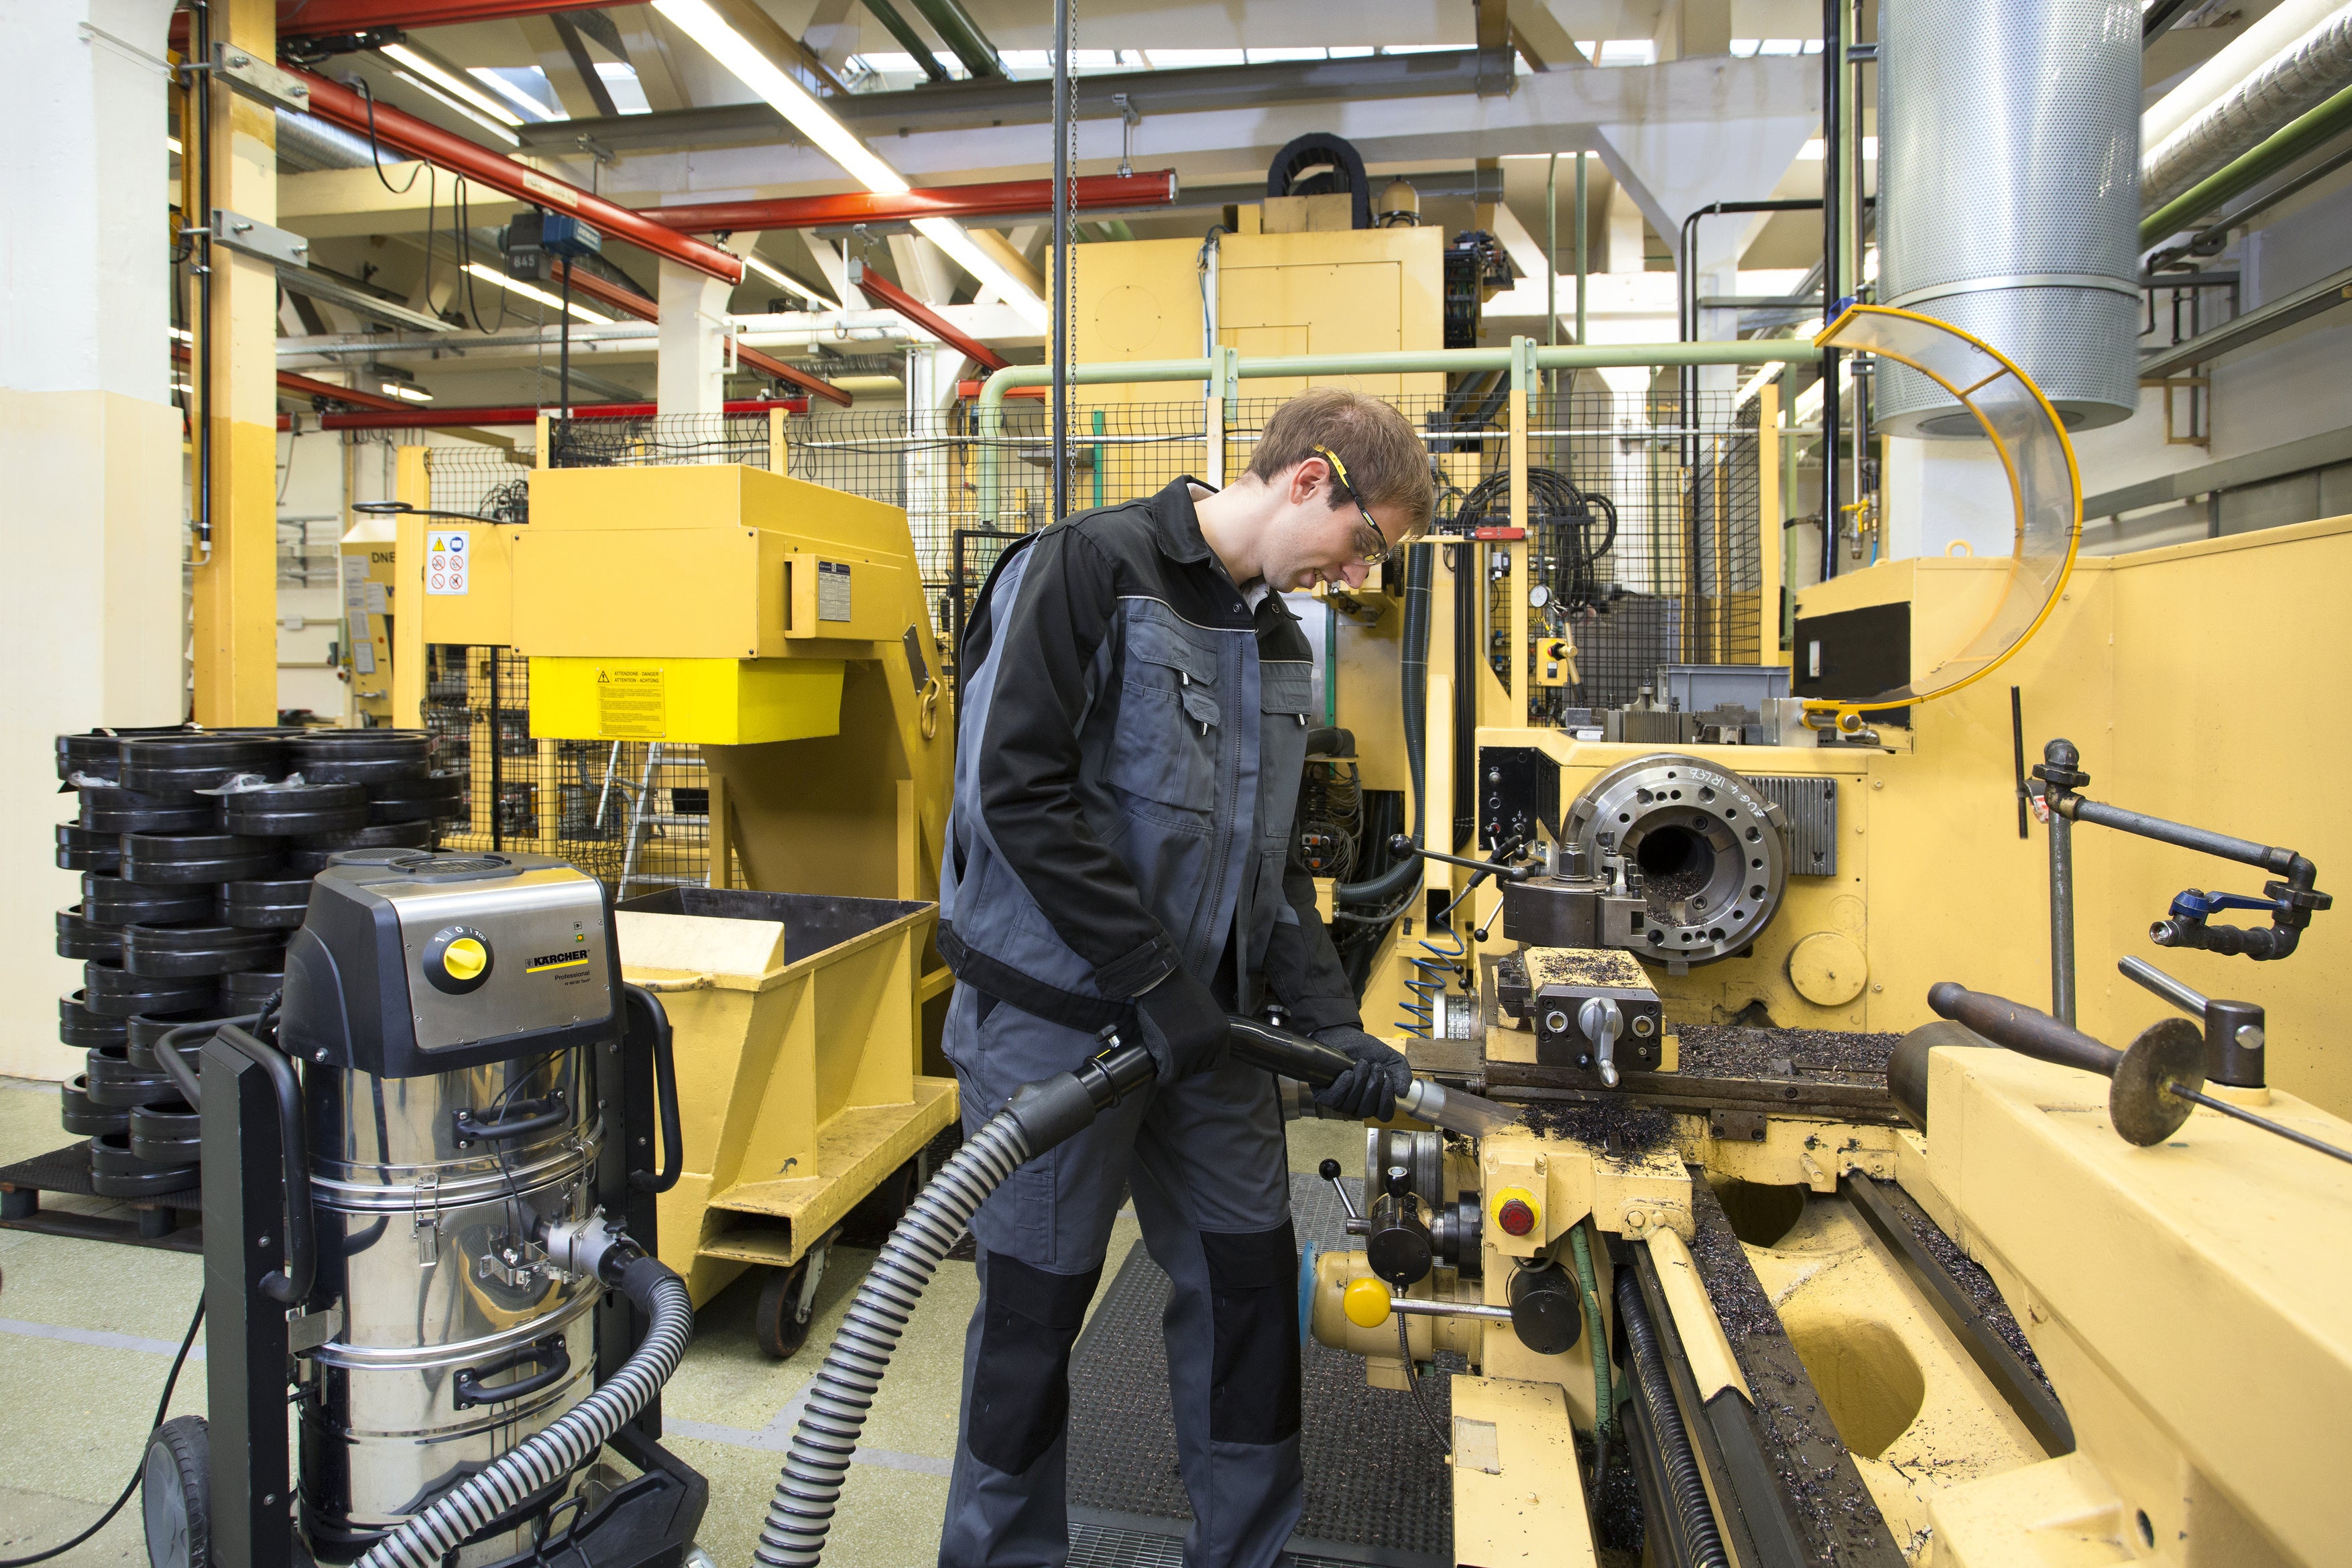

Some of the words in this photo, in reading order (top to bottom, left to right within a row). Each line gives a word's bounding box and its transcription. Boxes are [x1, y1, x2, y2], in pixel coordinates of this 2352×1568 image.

[514, 255, 536, 267] 845
[534, 949, 588, 967] KÄRCHER
[554, 970, 590, 981] Professional
